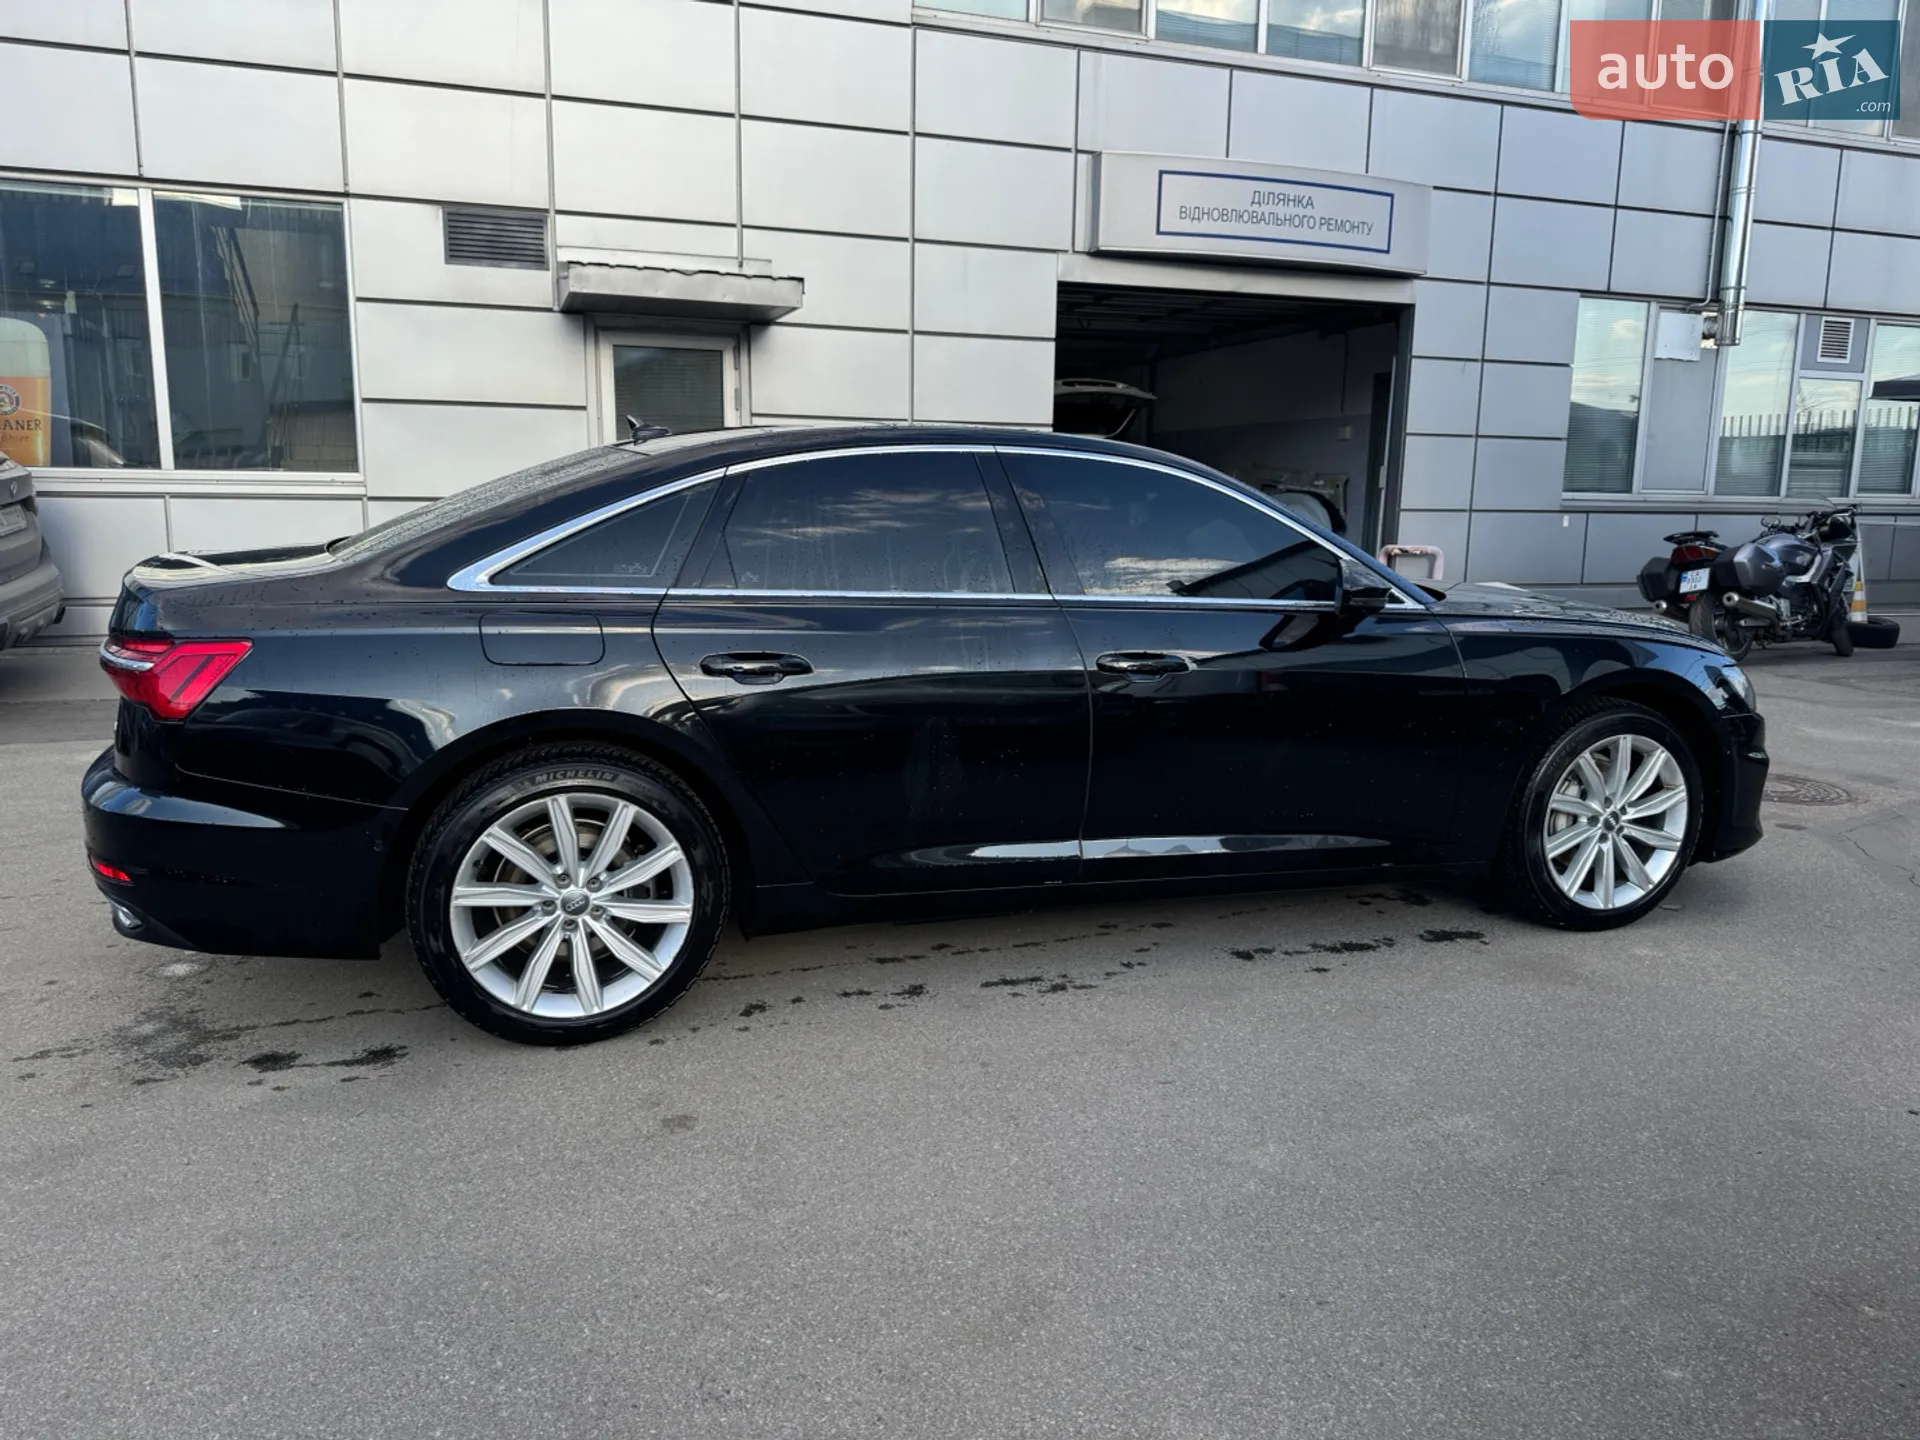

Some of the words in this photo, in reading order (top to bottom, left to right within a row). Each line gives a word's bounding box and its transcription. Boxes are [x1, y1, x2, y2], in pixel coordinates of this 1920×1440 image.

[1250, 190, 1315, 209] ДІЛЯНКА
[1178, 205, 1317, 230] ВІДНОВЛЮВАЛЬНОГО
[1319, 216, 1374, 236] РЕМОНТУ
[534, 769, 615, 784] MICHELIN
